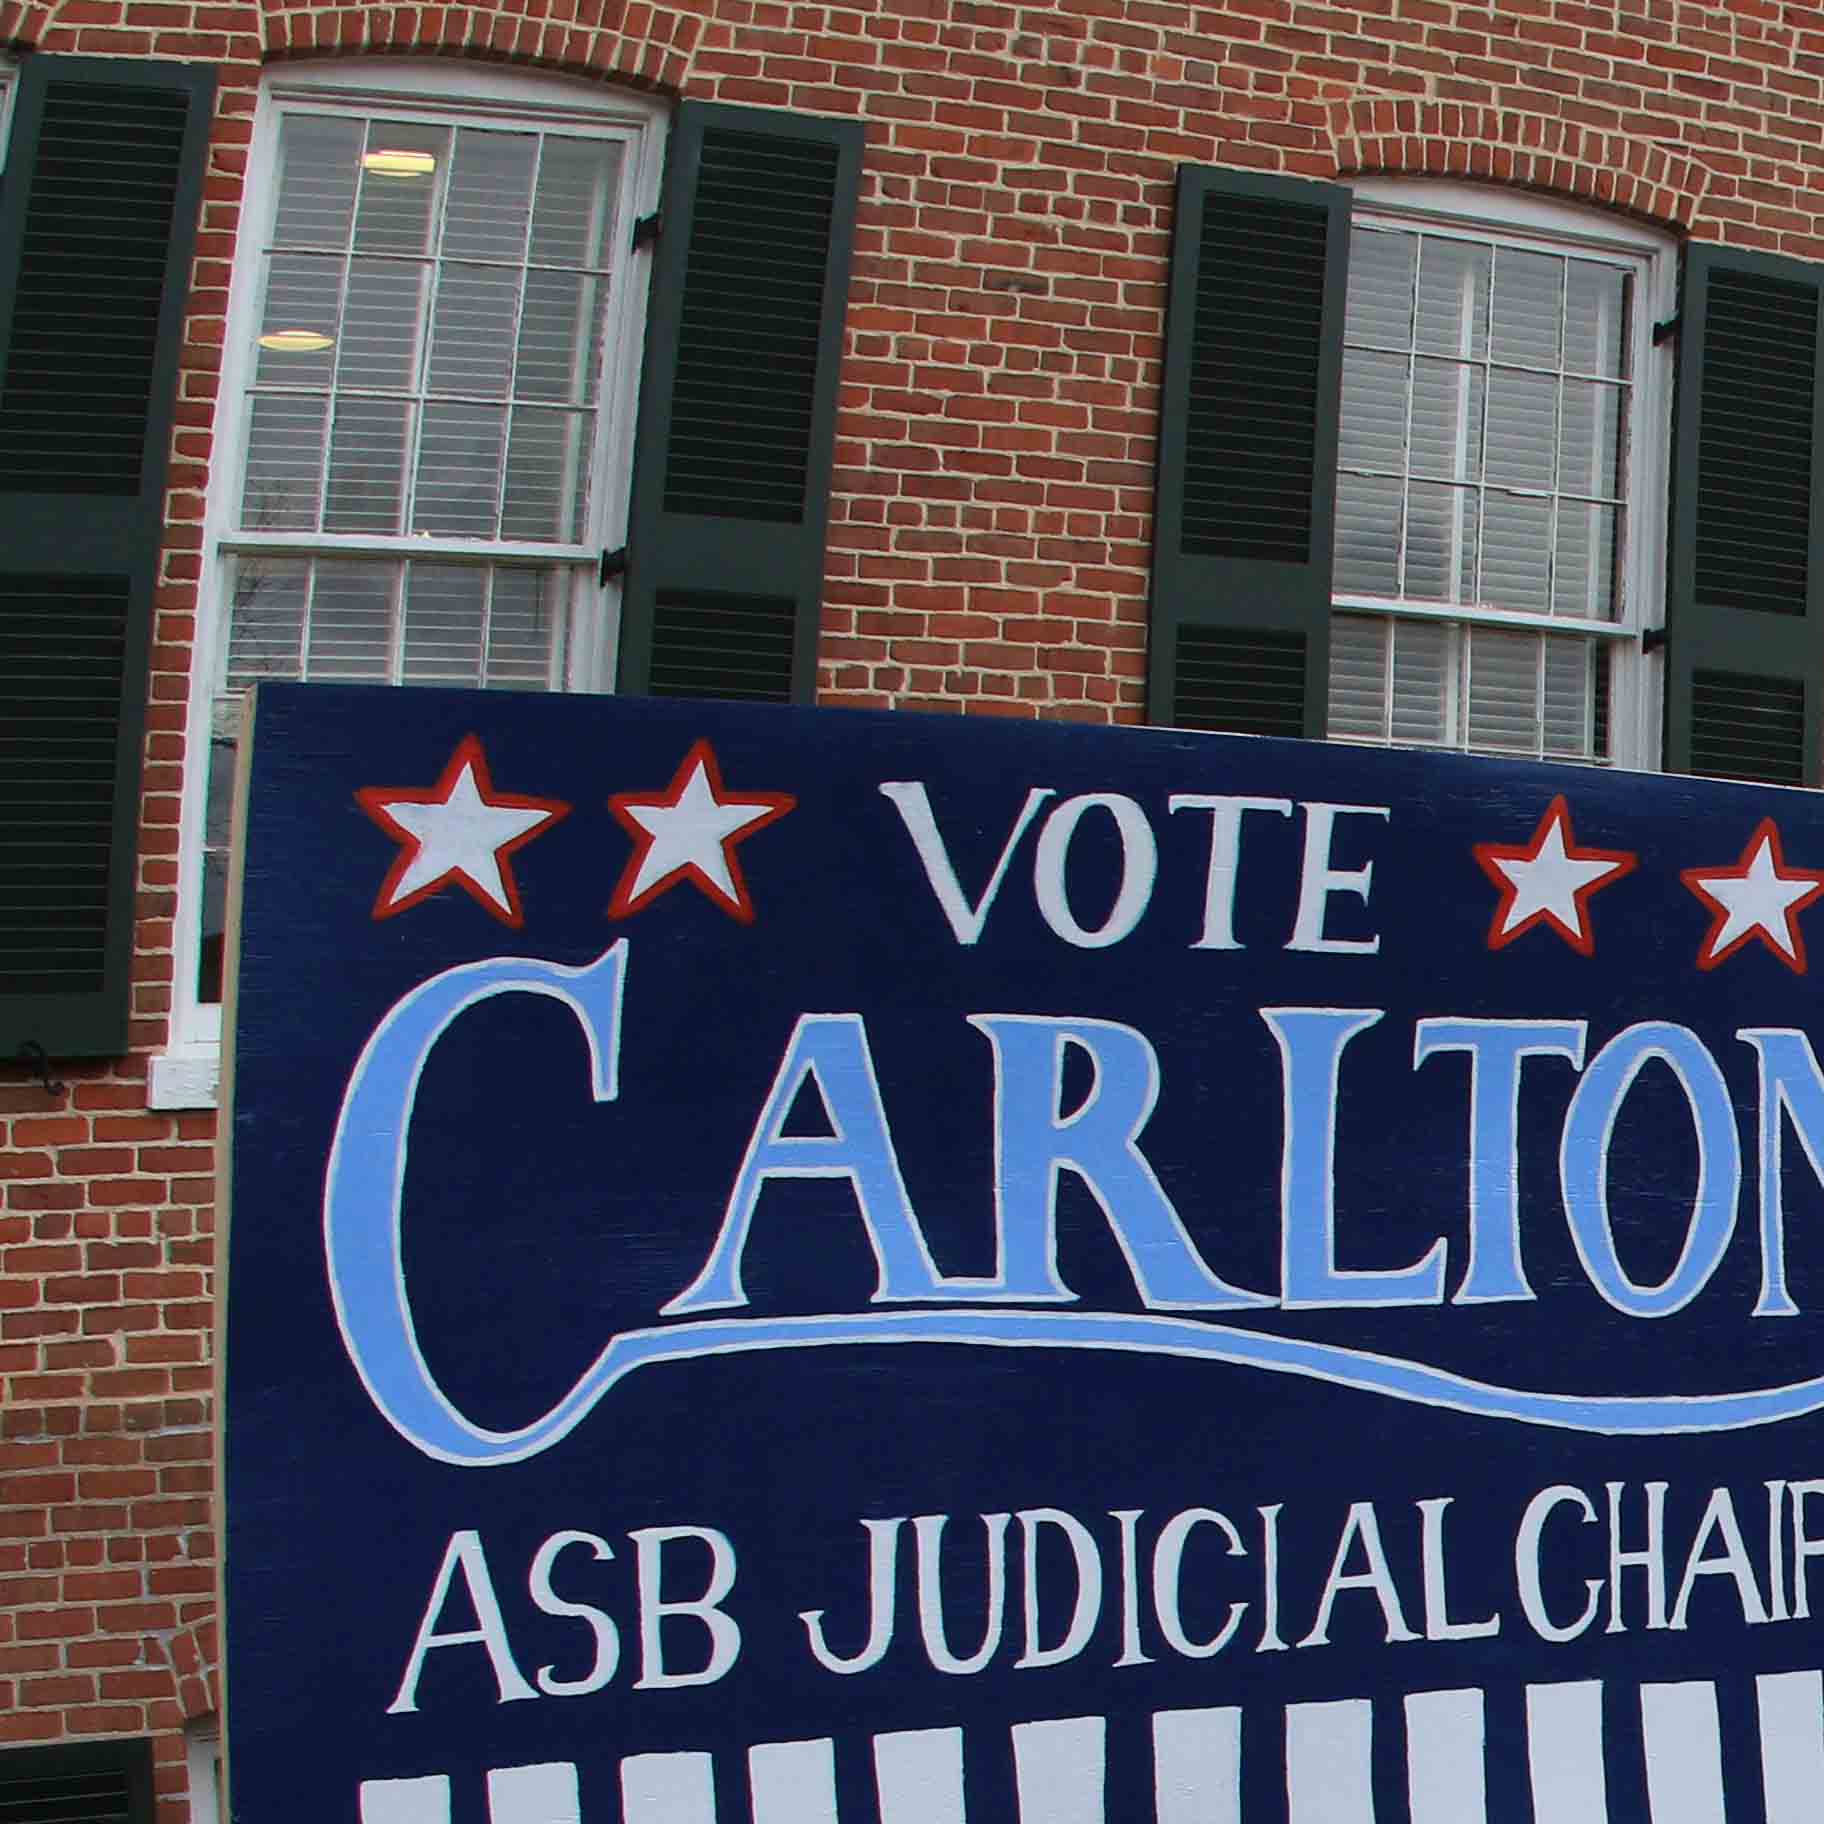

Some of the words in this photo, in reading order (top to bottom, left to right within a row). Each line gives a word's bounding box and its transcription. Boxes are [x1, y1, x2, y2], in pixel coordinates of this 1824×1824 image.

[879, 780, 1393, 955] VOTE
[388, 1525, 746, 1715] ASB
[800, 1494, 1502, 1677] JUDICIAL
